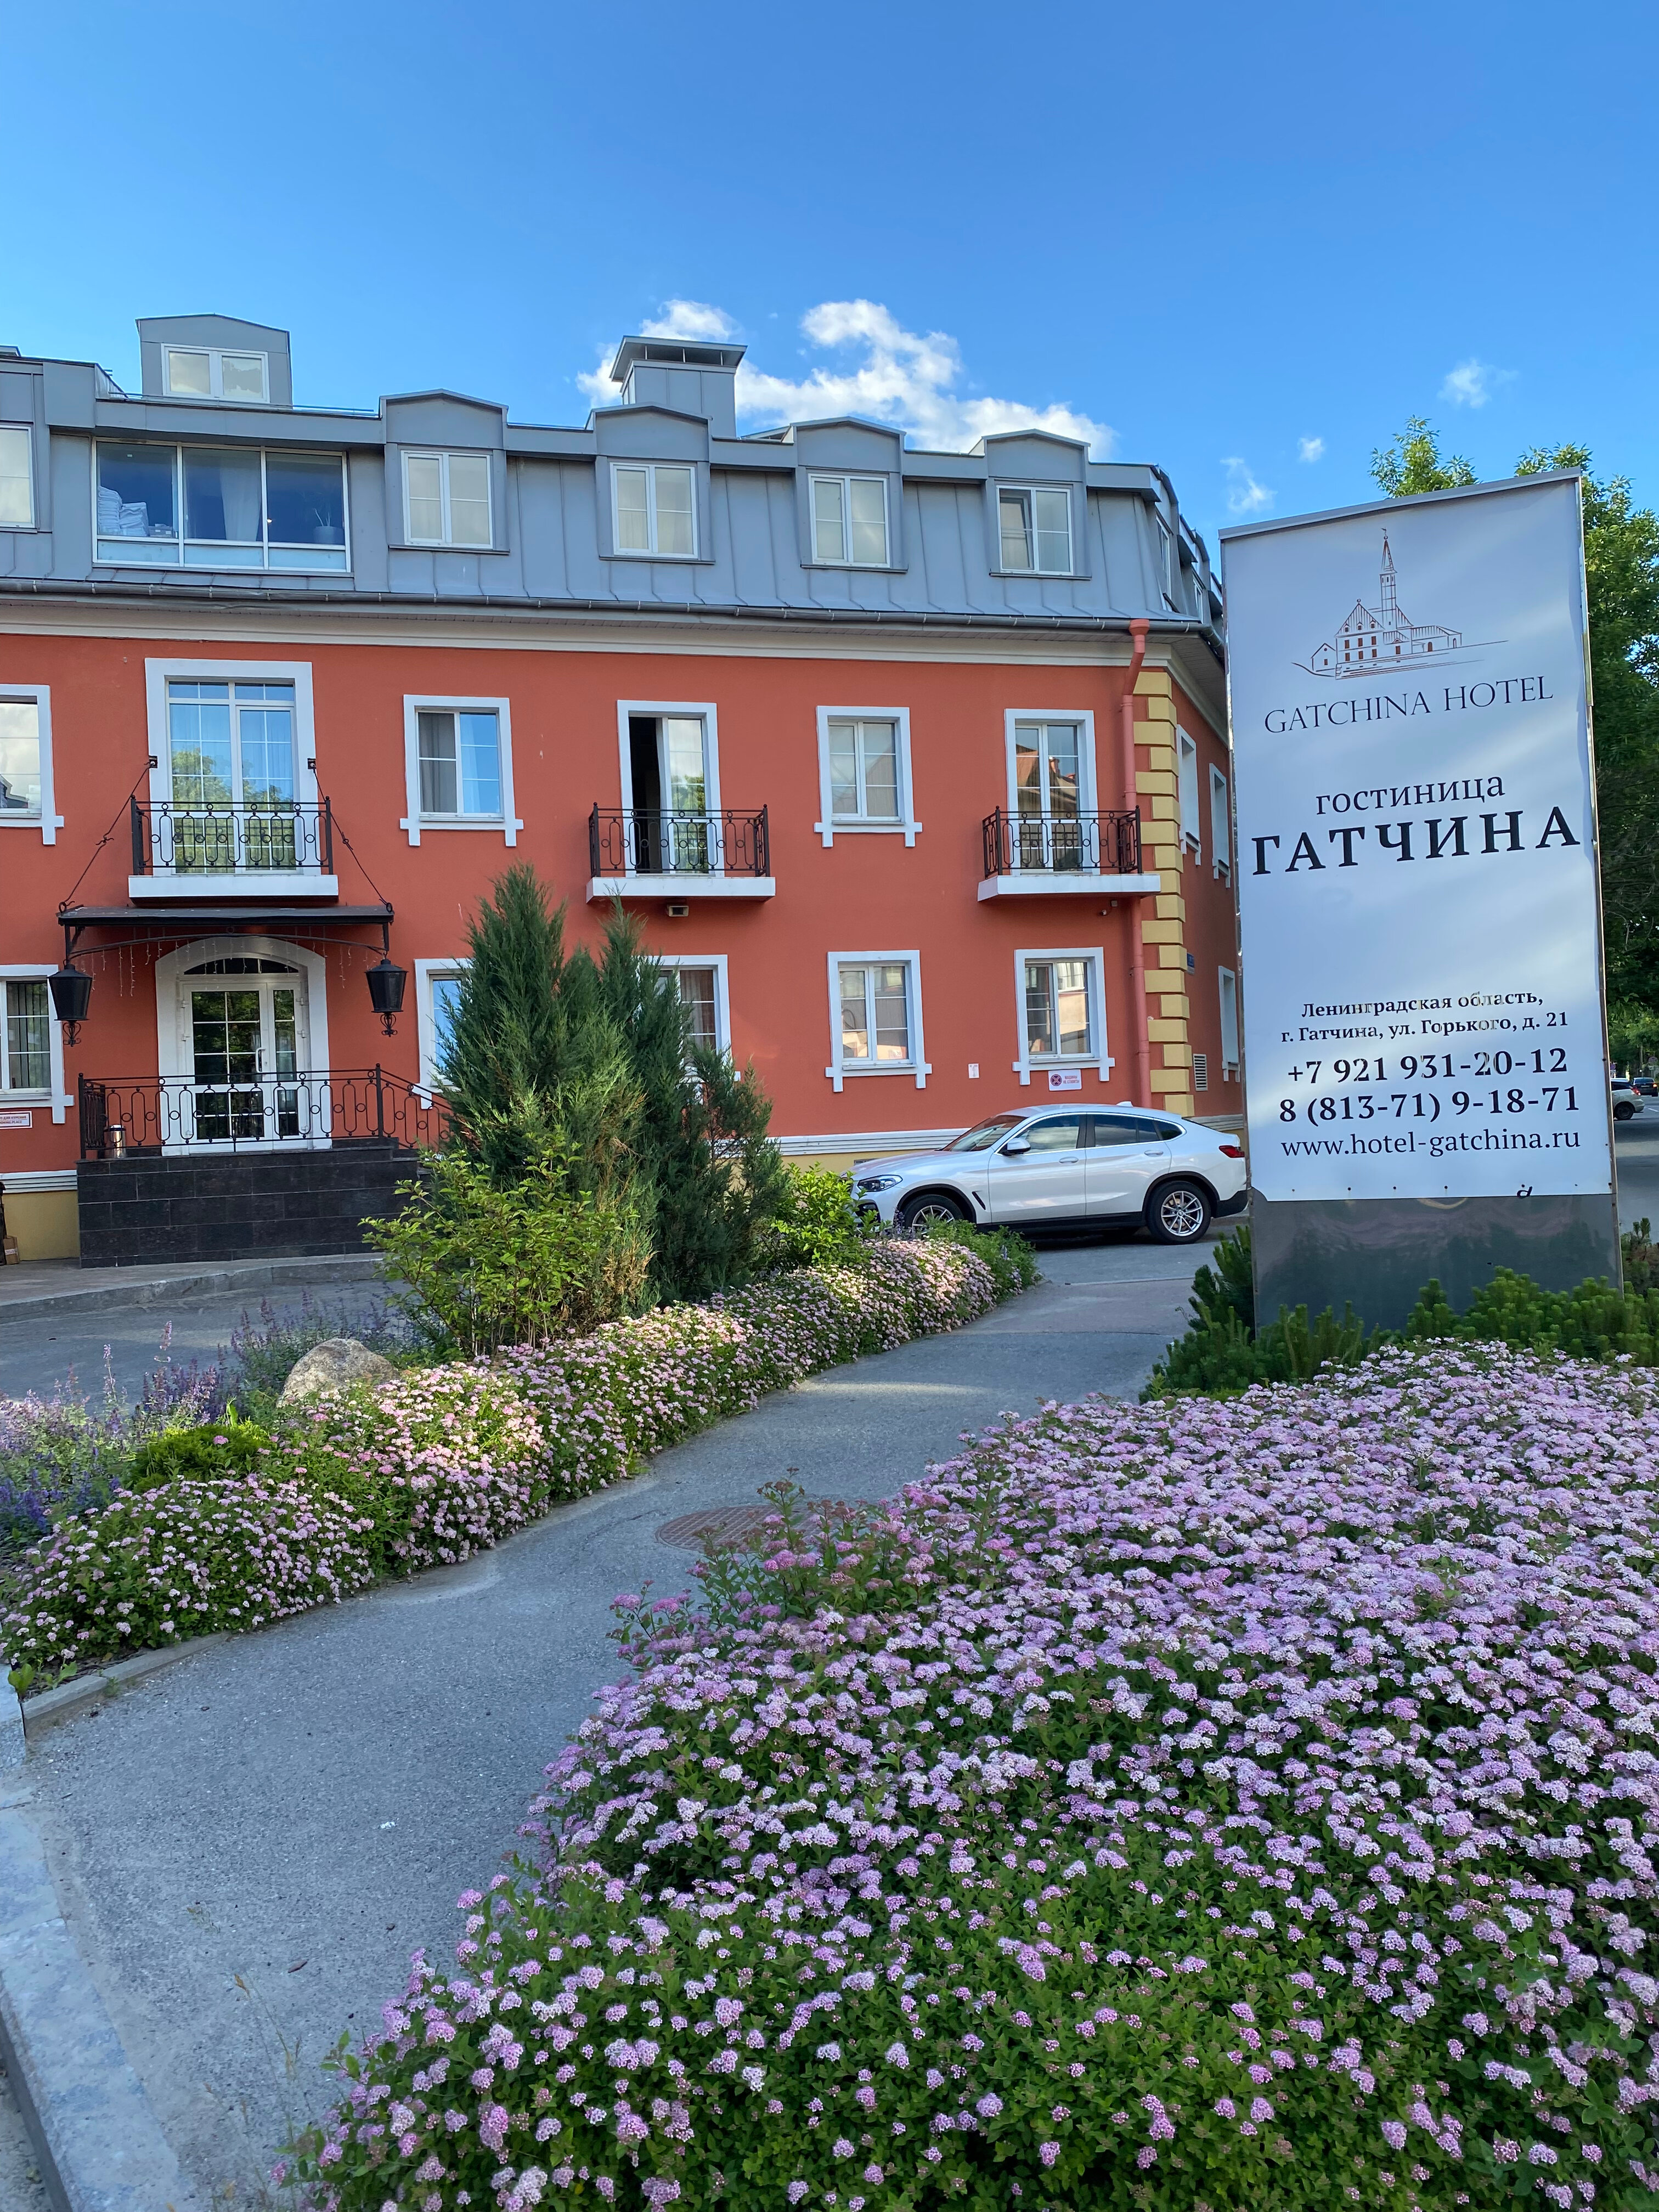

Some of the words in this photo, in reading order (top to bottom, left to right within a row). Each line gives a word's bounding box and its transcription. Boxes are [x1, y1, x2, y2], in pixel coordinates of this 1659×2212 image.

[1265, 692, 1431, 733] GATCHINA
[1443, 676, 1553, 711] HOTEL
[1316, 777, 1505, 815] гостиница
[1251, 806, 1580, 875] ГАТЧИНА
[1302, 998, 1452, 1017] Ленинградская
[1458, 991, 1543, 1007] область,
[1282, 1032, 1293, 1042] г.
[1299, 1027, 1383, 1041] Гатчина,
[1388, 1025, 1415, 1039] ул.
[1421, 1019, 1517, 1036] Горького,
[1522, 1018, 1540, 1031] д.
[1547, 1012, 1568, 1026] 21
[1288, 1061, 1322, 1084] +7
[1334, 1057, 1387, 1082] 921
[1401, 1048, 1567, 1079] 931-20-12
[1280, 1099, 1296, 1122] 8
[1308, 1093, 1440, 1127] (813-71)
[1452, 1086, 1579, 1115] 9-18-71
[1280, 1128, 1581, 1156] www.hotel-gatchina.ru
